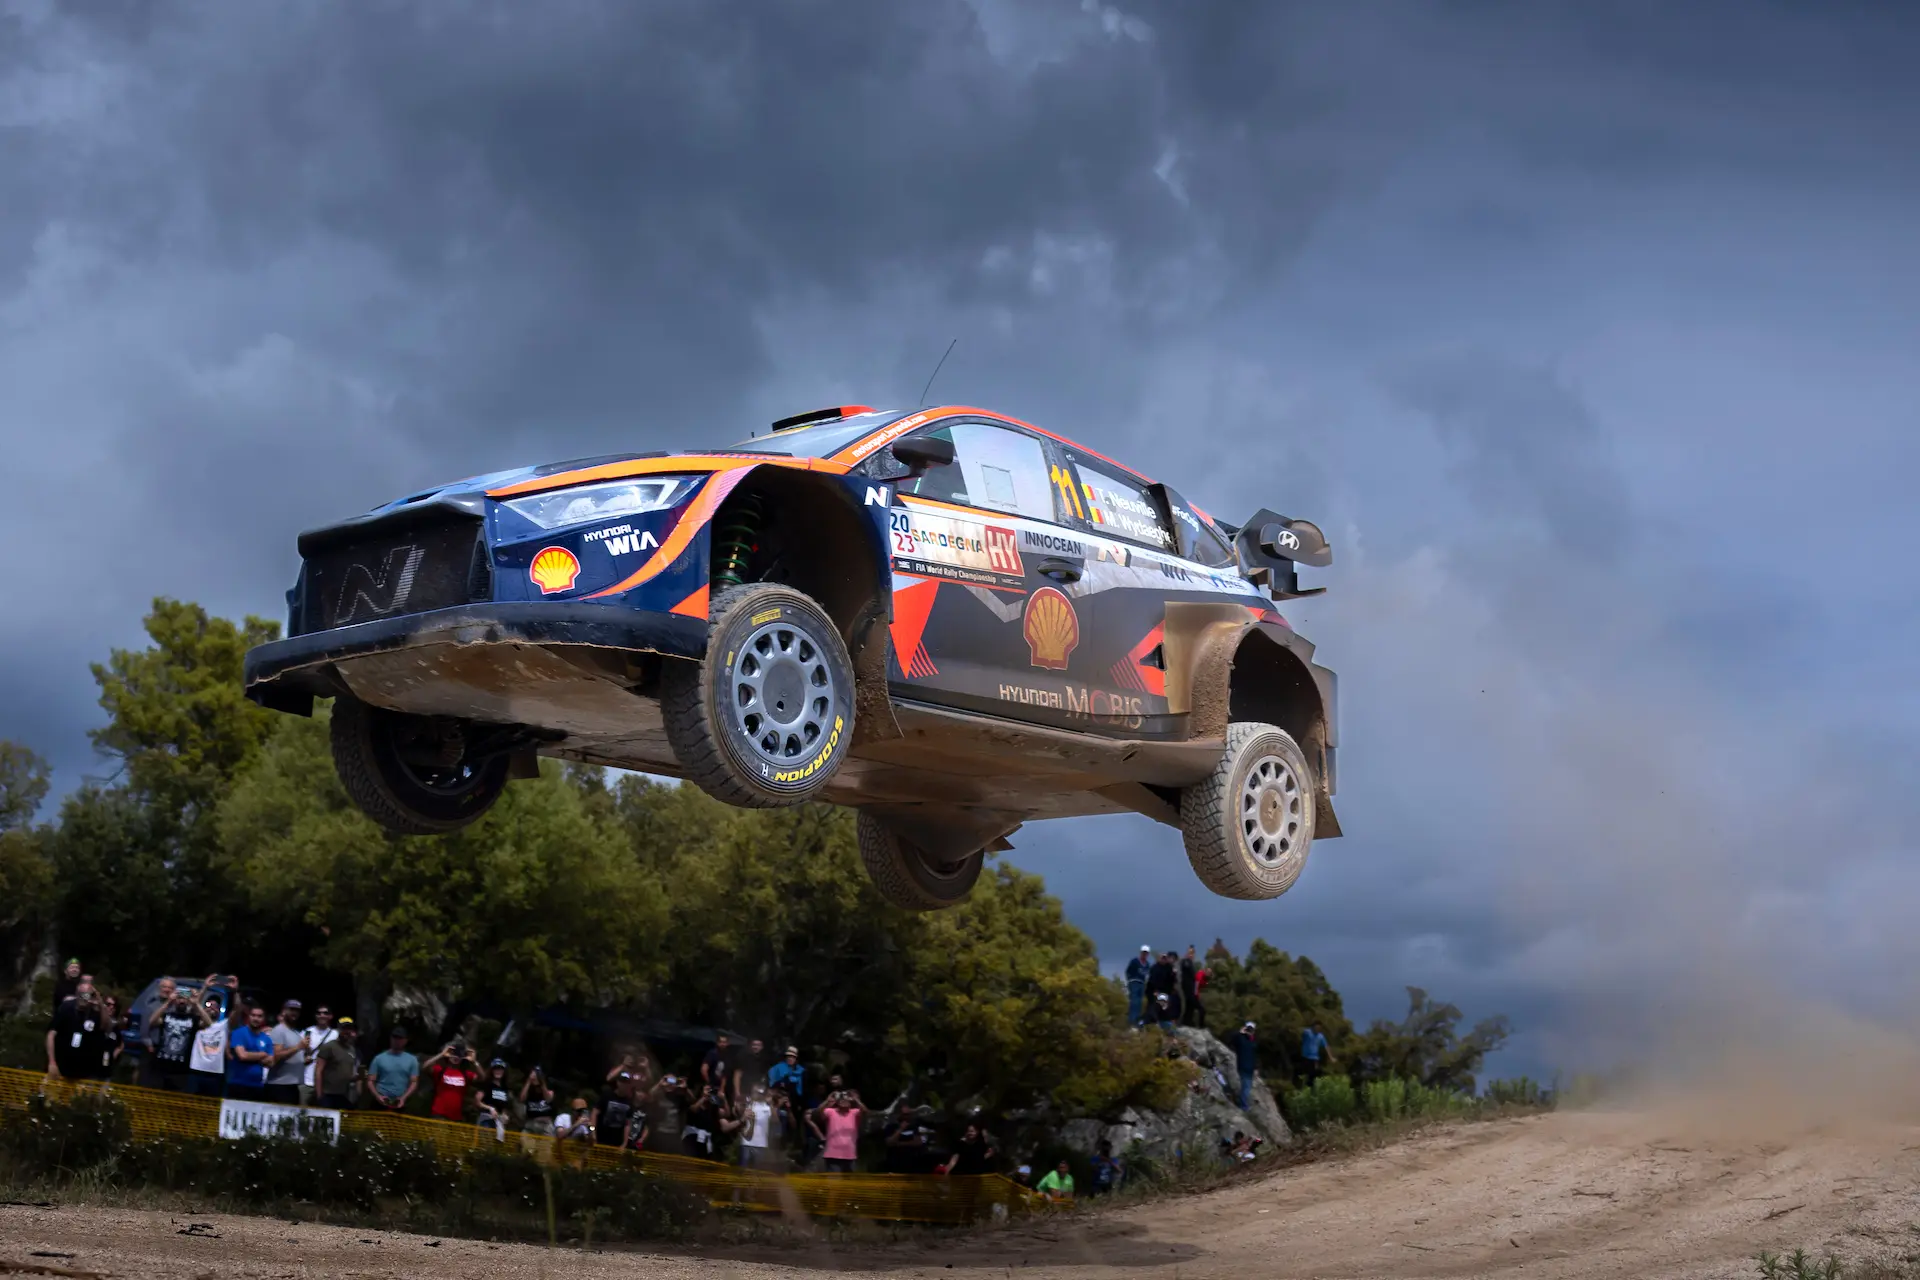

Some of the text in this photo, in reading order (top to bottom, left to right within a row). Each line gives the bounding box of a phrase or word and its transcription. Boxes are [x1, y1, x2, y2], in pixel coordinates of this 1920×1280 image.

[1050, 464, 1084, 520] 11
[1095, 487, 1157, 519] T. Neuville
[890, 512, 909, 533] 20
[1103, 510, 1120, 528] M.
[583, 524, 632, 542] HYUNDAI
[894, 532, 915, 553] 23
[910, 528, 985, 553] SARDEGNA
[1024, 531, 1082, 555] INNOCEAN
[915, 563, 926, 573] FIA
[926, 565, 943, 575] World
[943, 567, 958, 579] Rally
[959, 569, 997, 584] Championship
[999, 684, 1143, 730] HYUNDAI MOBIS
[774, 714, 844, 782] SCORPION
